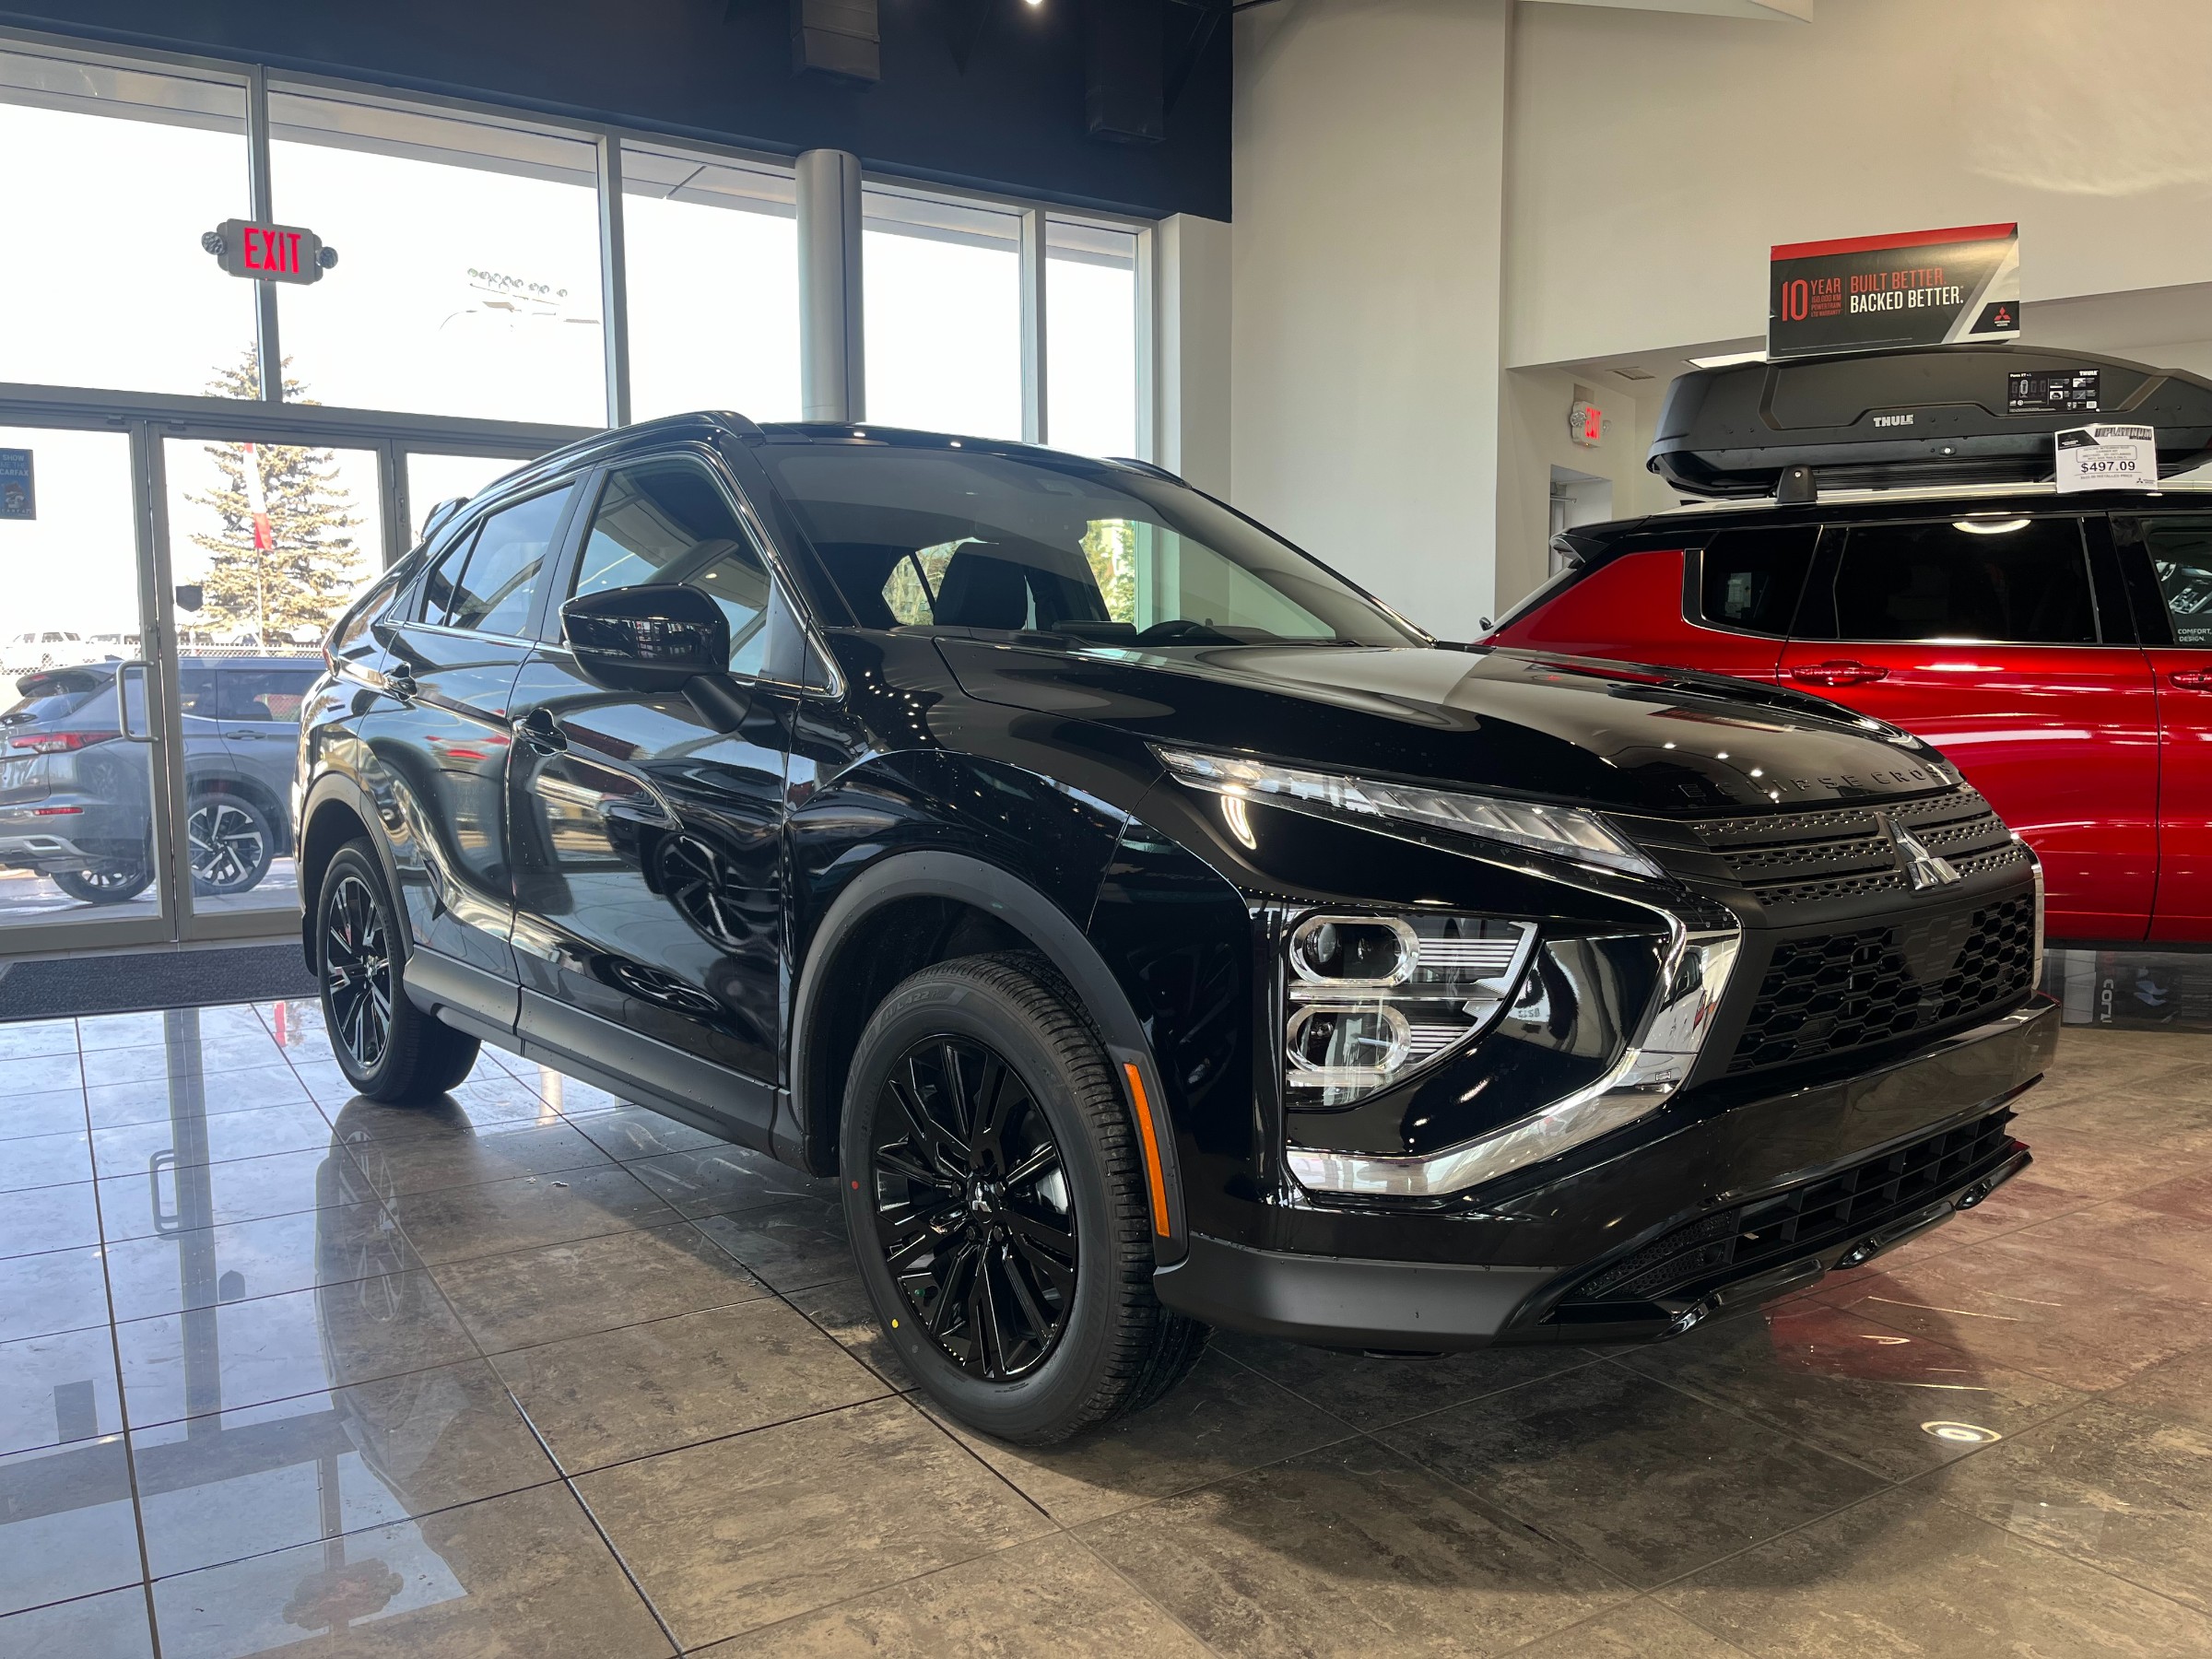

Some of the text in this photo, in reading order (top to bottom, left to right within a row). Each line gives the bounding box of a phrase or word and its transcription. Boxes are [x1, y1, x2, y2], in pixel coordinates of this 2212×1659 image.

[244, 227, 301, 275] EXIT
[1810, 277, 1841, 296] YEAR
[1850, 267, 1947, 294] BUILT BETTER.
[1782, 279, 1808, 322] 10
[1850, 290, 1903, 313] BACKED
[1873, 414, 1914, 428] THULE
[0, 468, 29, 477] CARFAX
[2080, 461, 2136, 475] $497.09
[1872, 763, 1953, 785] CROSS
